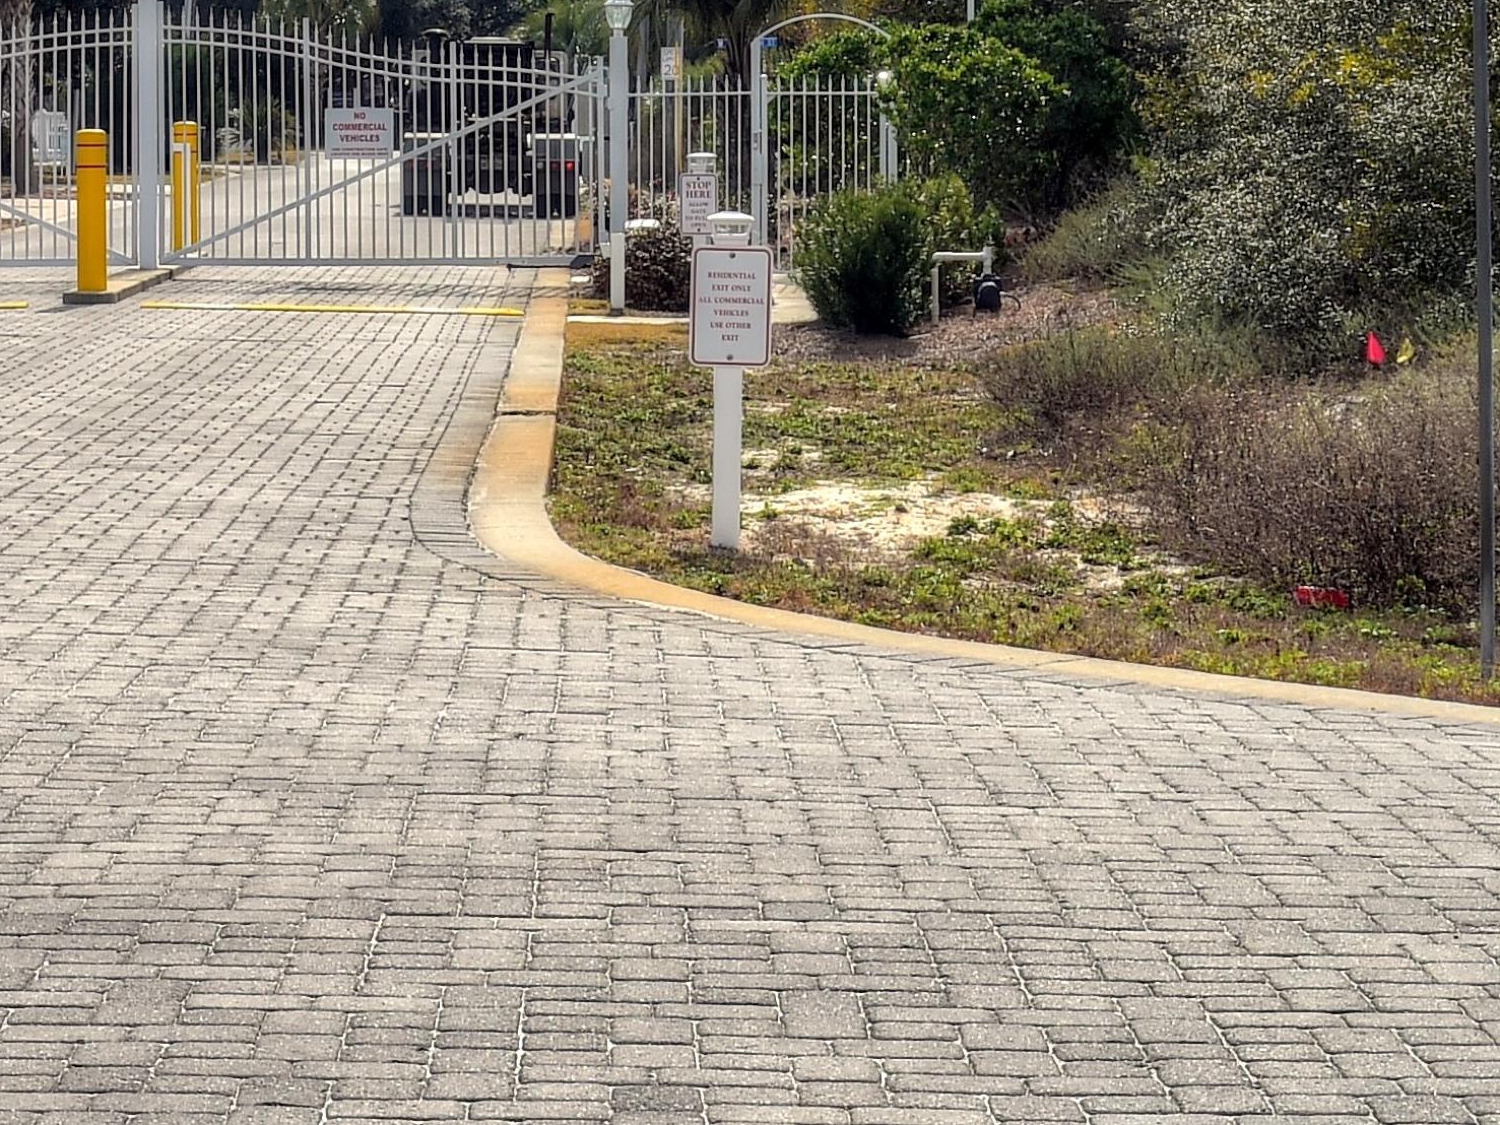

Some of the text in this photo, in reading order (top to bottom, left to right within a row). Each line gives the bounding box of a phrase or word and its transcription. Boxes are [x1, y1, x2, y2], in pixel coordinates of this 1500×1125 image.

[354, 111, 366, 120] NO
[332, 123, 388, 131] COMMERCIAL
[339, 134, 380, 143] VEHICLES
[686, 181, 712, 190] STOP
[686, 190, 712, 199] HERE
[707, 271, 756, 280] RESIDENTIAL
[731, 284, 752, 292] ONLY
[713, 309, 749, 317] VEHICLES
[710, 321, 752, 329] USE OTHER
[721, 334, 739, 342] EXIT
